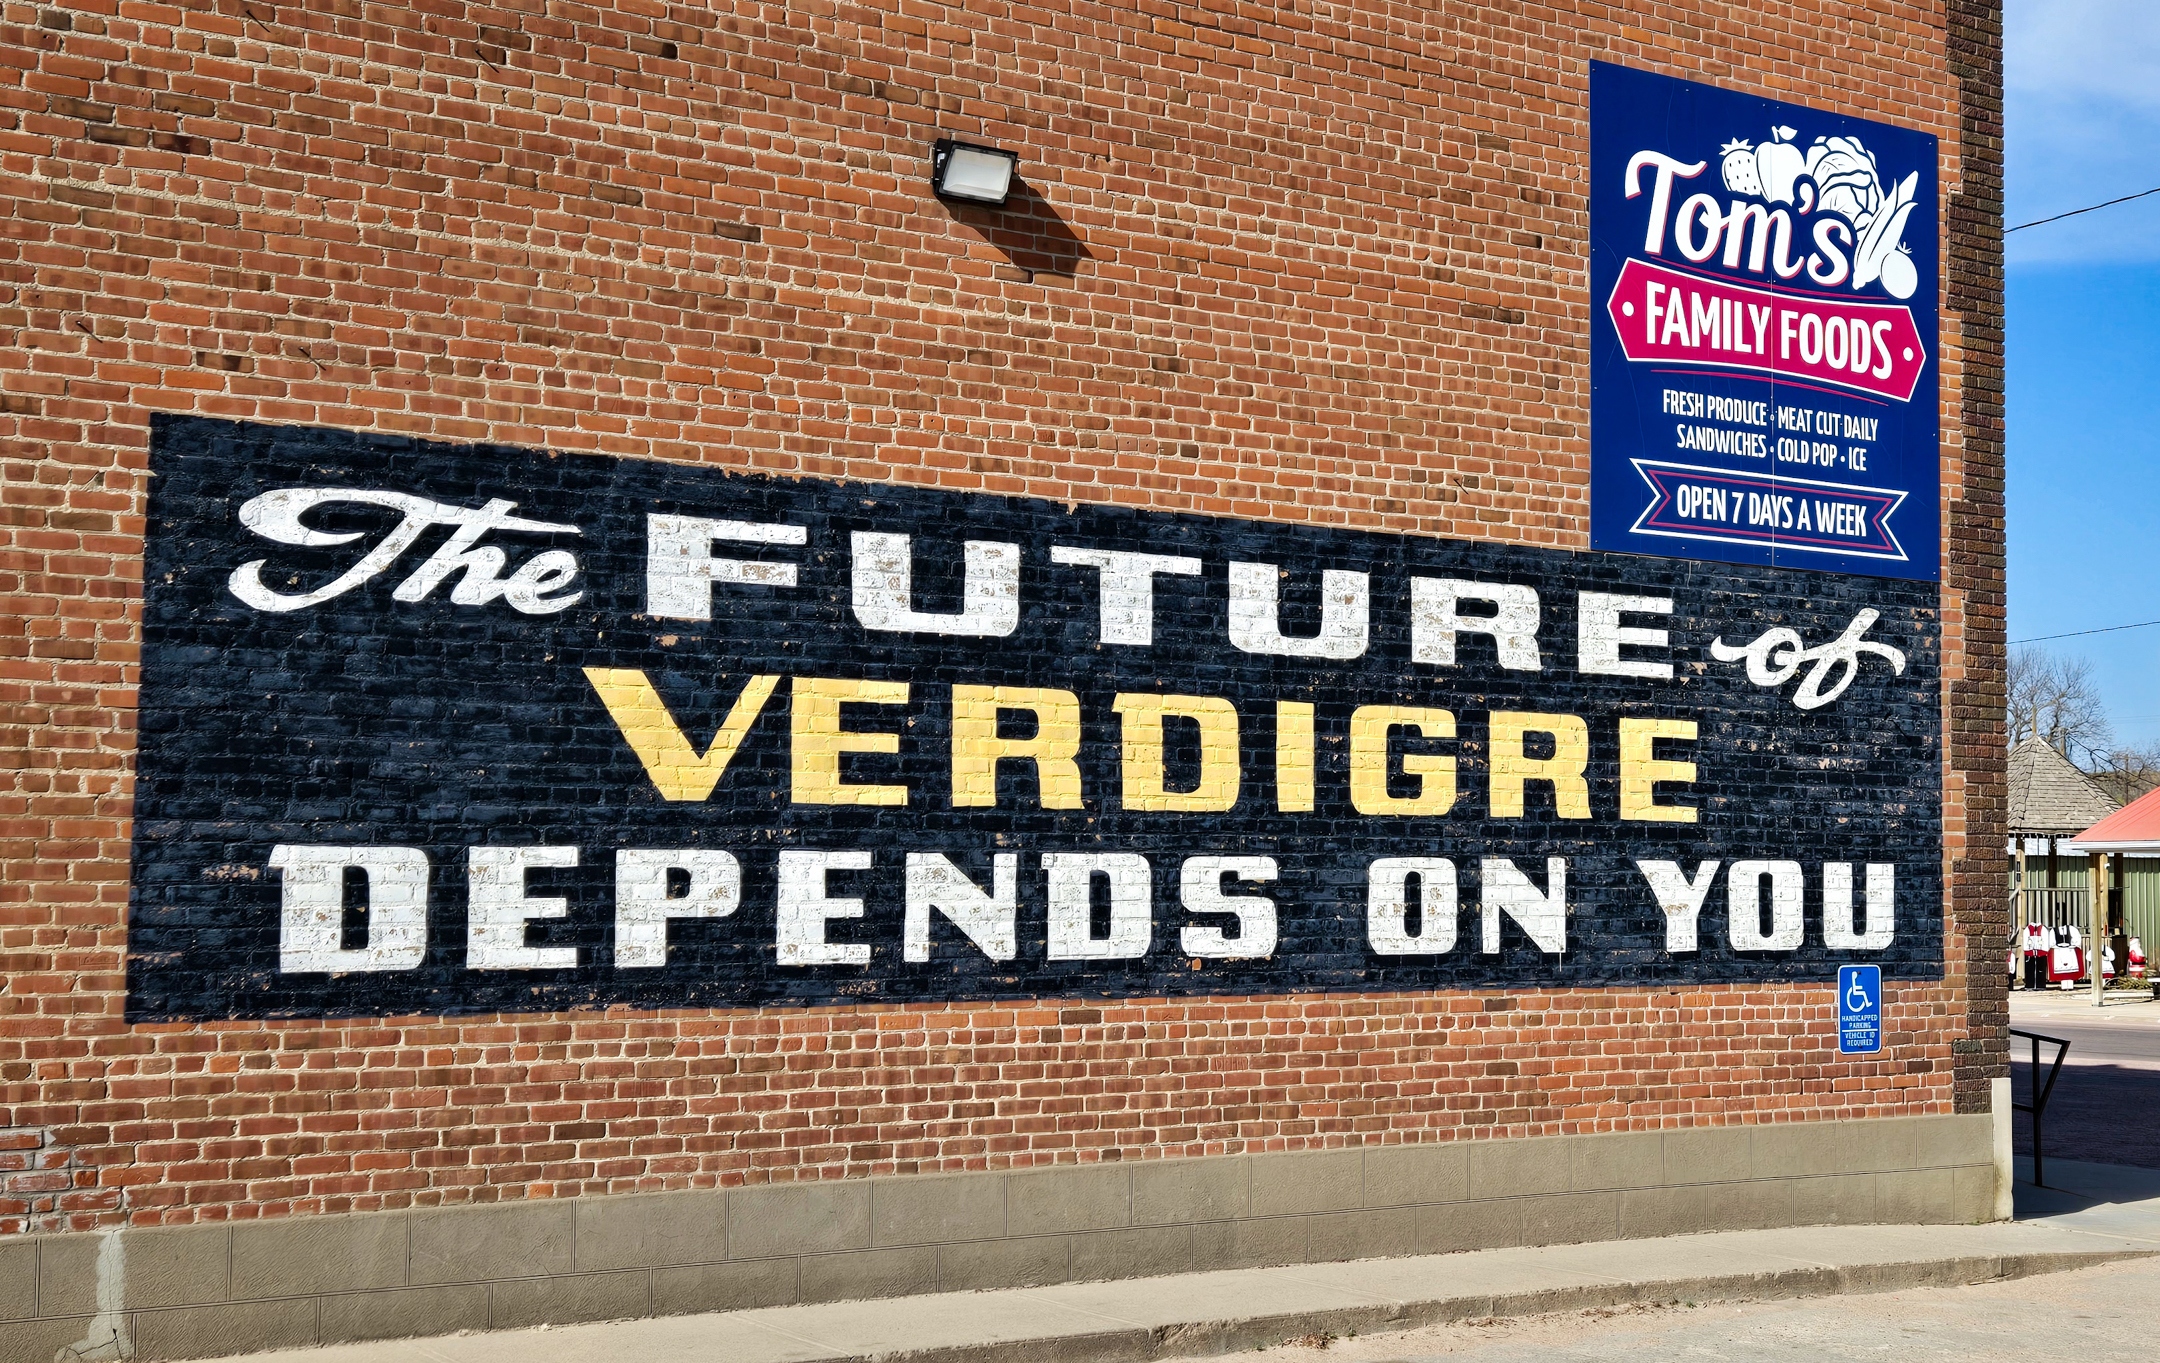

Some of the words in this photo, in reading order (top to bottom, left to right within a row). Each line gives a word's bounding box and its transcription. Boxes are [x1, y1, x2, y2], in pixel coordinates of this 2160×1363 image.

[1625, 150, 1853, 287] Tom's
[1646, 280, 1771, 355] FAMILY
[1780, 309, 1893, 380] FOODS
[1664, 389, 1703, 417] FRESH
[1708, 395, 1766, 425] PRODUCE
[1778, 406, 1813, 432] MEAT
[1816, 411, 1841, 436] CUT
[1844, 415, 1878, 441] DAILY
[1677, 424, 1767, 458] SANDWICHES
[1778, 438, 1809, 463] COLD
[1813, 442, 1837, 467] POP
[1849, 447, 1866, 471] ICE
[1678, 485, 1726, 521] OPEN
[1732, 492, 1744, 523] 7
[1749, 494, 1793, 529] DAYS
[1797, 499, 1811, 530] A
[1815, 501, 1866, 536] WEEK
[229, 488, 583, 614] The
[647, 513, 1674, 679] FUTURE
[1711, 608, 1905, 709] of
[582, 667, 1697, 823] VERDIGRE
[268, 845, 1278, 975] DEPENDS
[1368, 857, 1567, 956] ON
[1636, 860, 1894, 952] YOU
[1842, 1014, 1878, 1022] HANDICAPPED
[1845, 1031, 1867, 1039] VEHICLE
[1869, 1031, 1876, 1039] ID
[1846, 1038, 1873, 1046] REQUIRED
